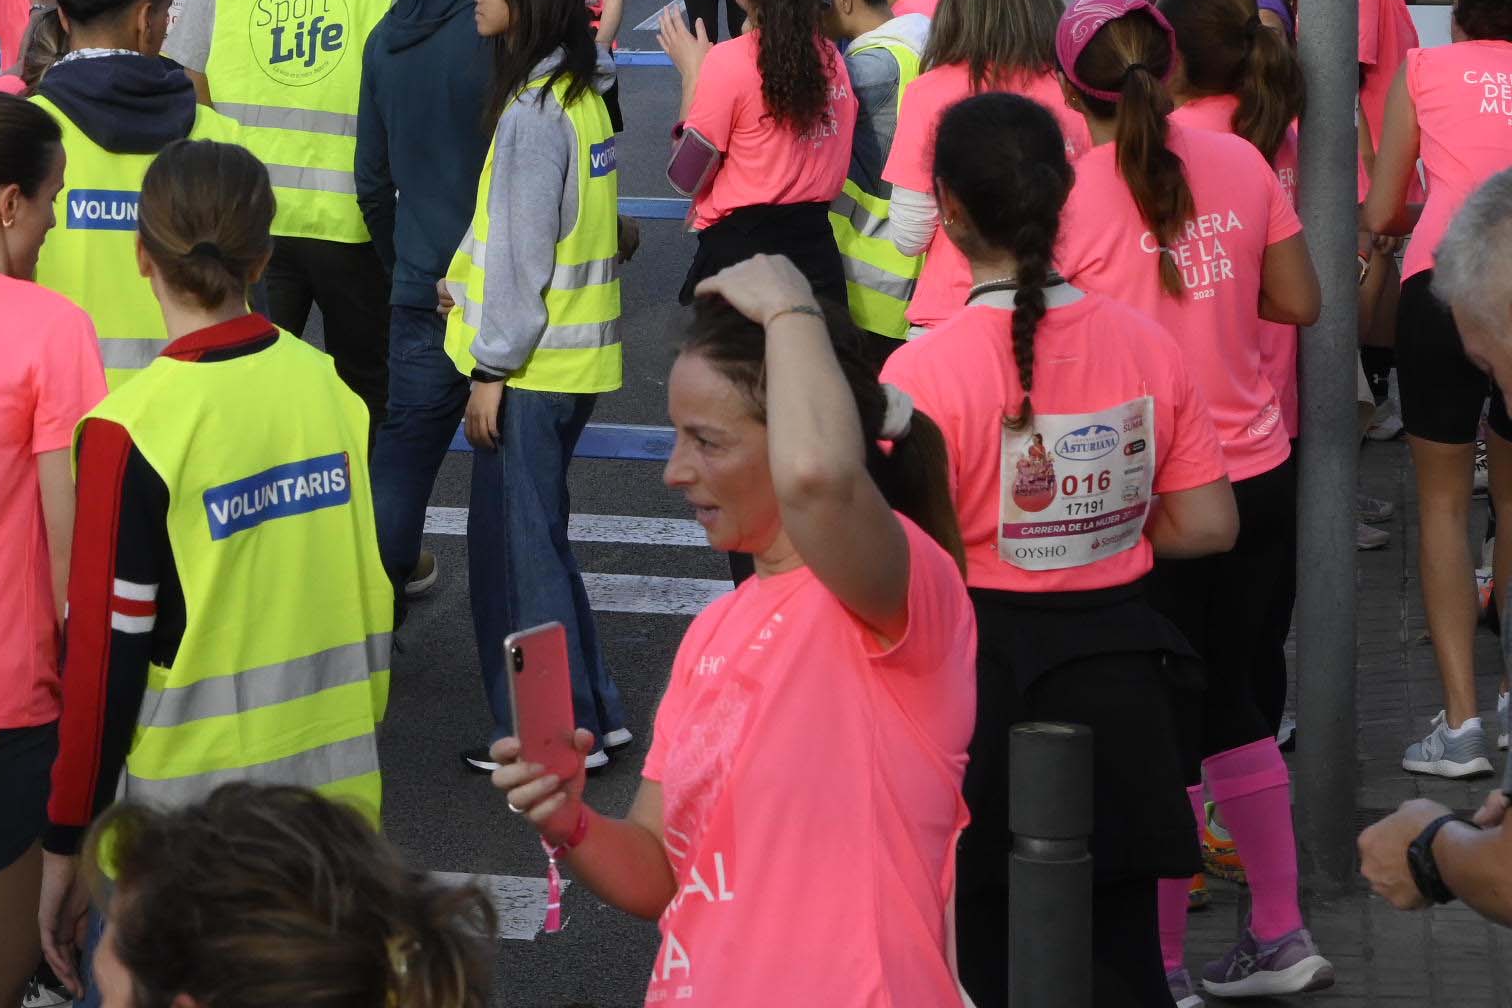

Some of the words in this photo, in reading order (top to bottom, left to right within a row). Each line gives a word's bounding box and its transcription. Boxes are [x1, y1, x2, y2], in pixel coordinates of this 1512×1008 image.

[268, 15, 344, 68] Life
[1480, 98, 1512, 116] MU
[70, 199, 139, 221] VOLUN
[1139, 209, 1244, 254] CRERA
[1198, 237, 1227, 262] LA
[1183, 259, 1235, 289] UJER
[1193, 288, 1216, 300] 2023
[1060, 437, 1116, 455] ASTURIANA
[1061, 469, 1113, 497] 016
[210, 467, 347, 527] VOLUNTARIS
[1066, 499, 1105, 516] 17191
[1021, 524, 1066, 535] CARRERA
[1068, 523, 1081, 531] DE
[1083, 521, 1094, 530] LA
[1096, 514, 1120, 527] MUJER
[1015, 545, 1067, 559] OYSHO
